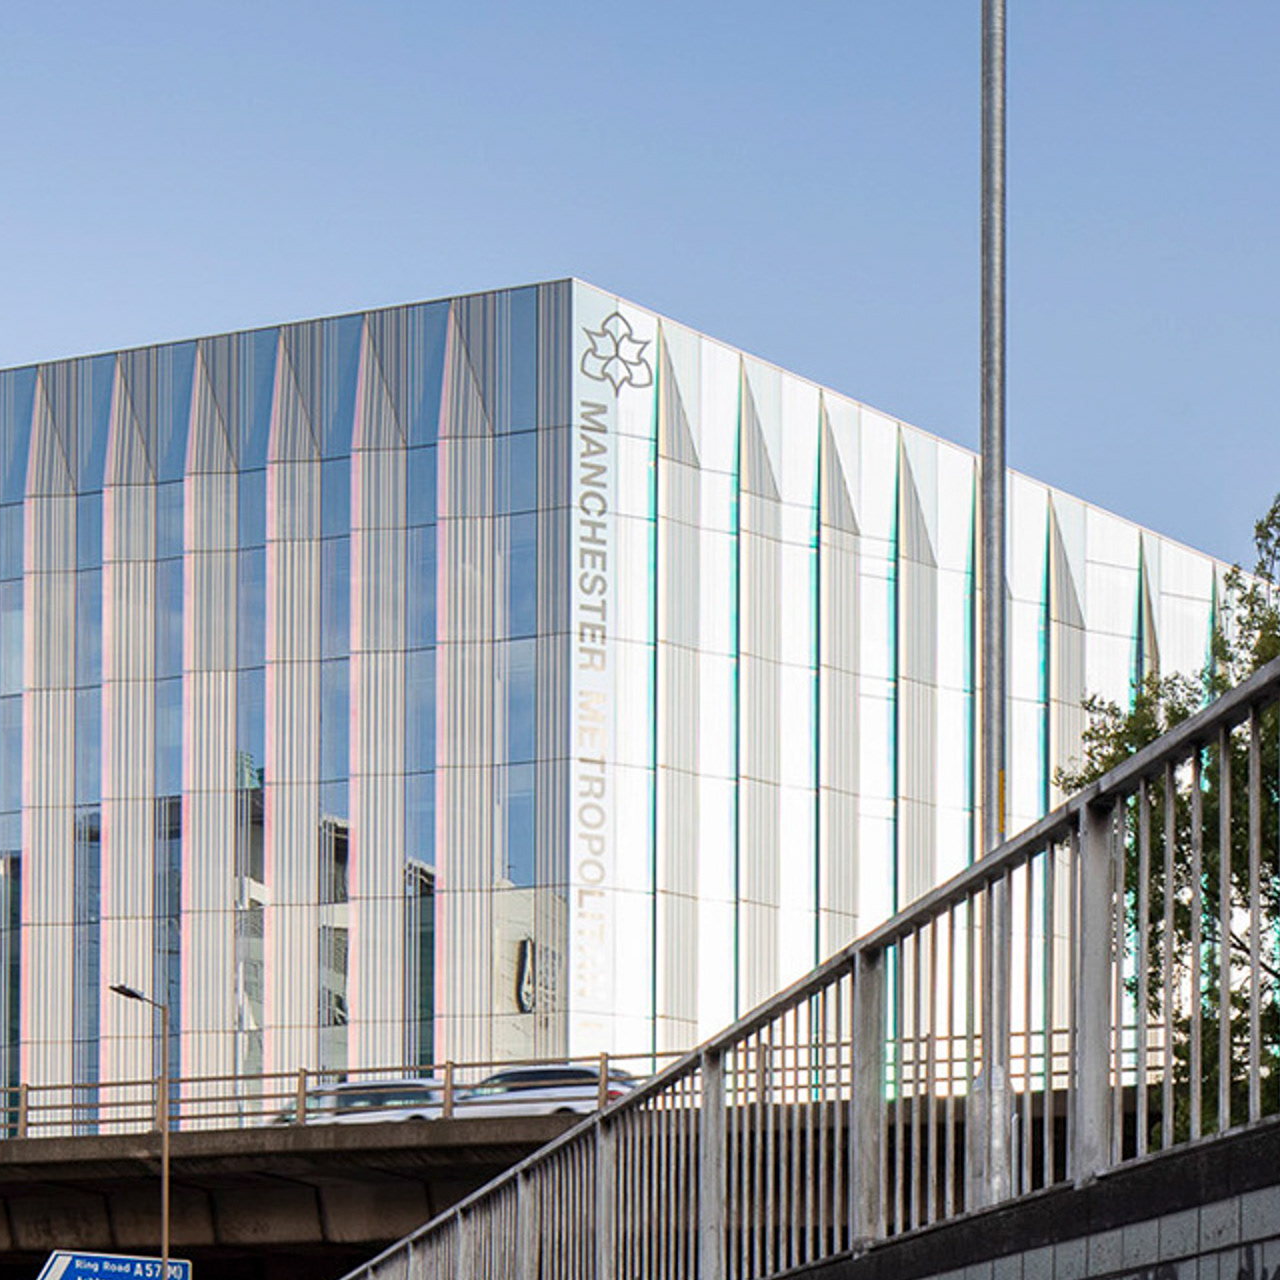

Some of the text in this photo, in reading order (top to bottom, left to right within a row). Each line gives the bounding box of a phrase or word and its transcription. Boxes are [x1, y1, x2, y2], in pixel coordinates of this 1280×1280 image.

[579, 401, 608, 671] MANCHESTER
[75, 1259, 99, 1273] Ring
[103, 1261, 131, 1273] Road
